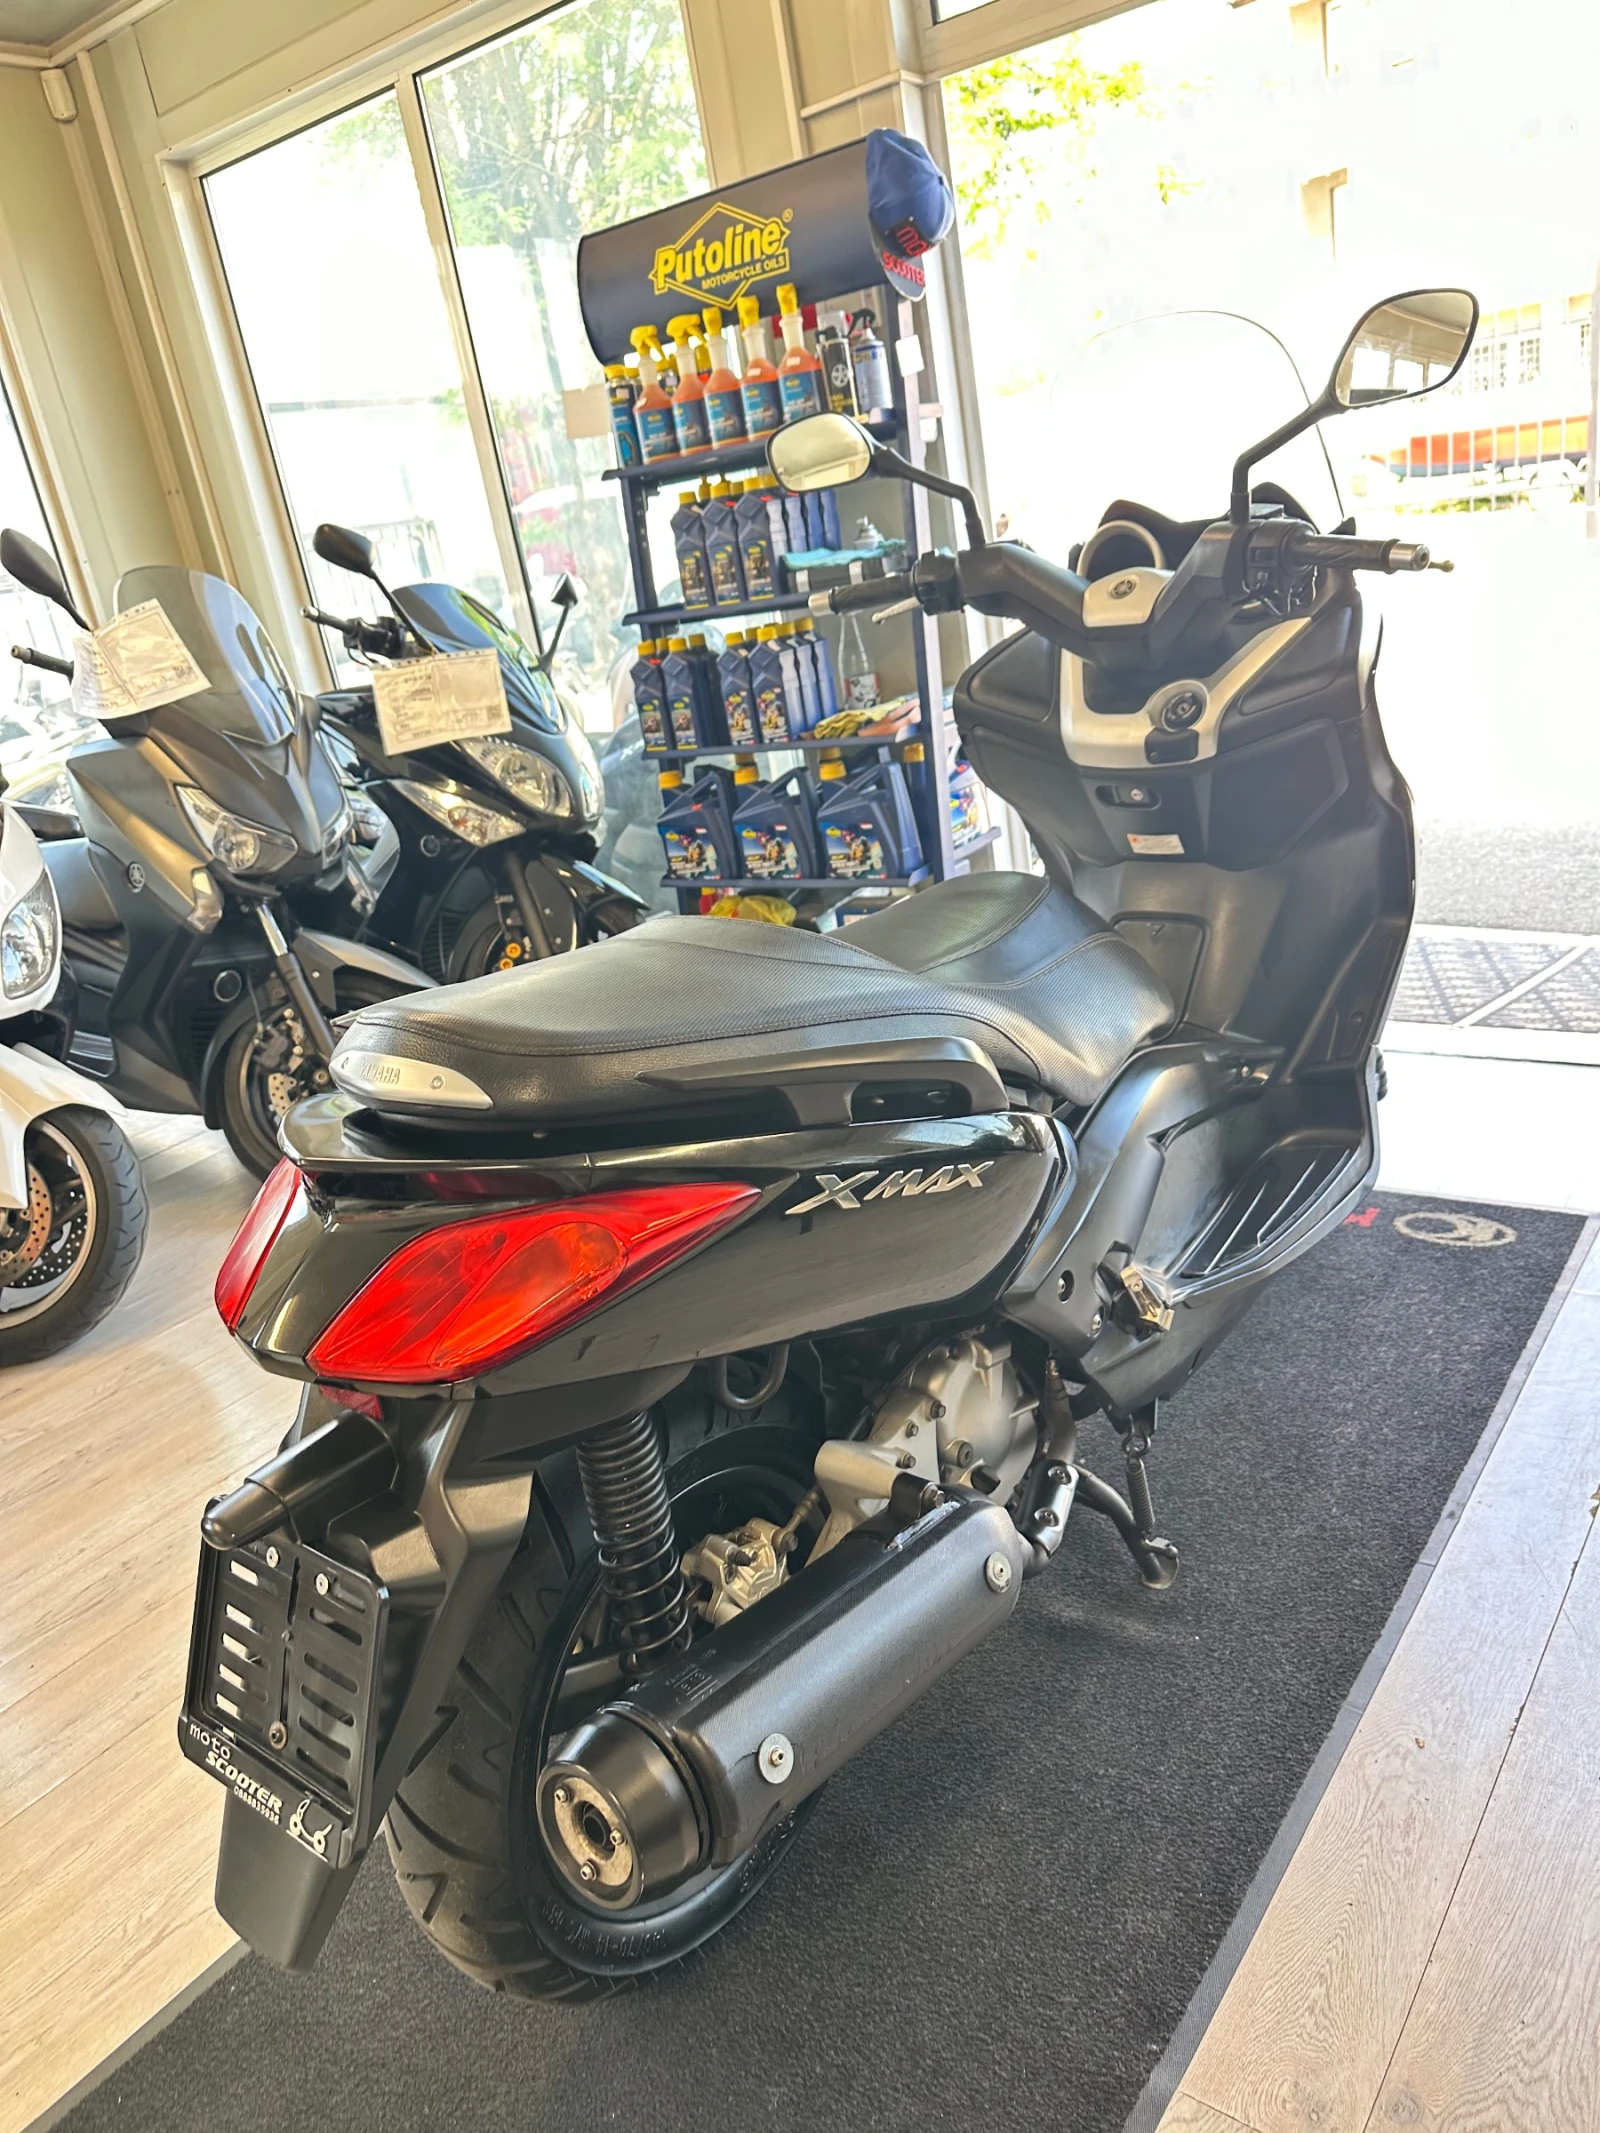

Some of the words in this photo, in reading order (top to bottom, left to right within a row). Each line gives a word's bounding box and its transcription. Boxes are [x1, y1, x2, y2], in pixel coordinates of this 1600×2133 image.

[657, 222, 781, 289] Putoline
[702, 262, 762, 290] MOTORCYCLE
[763, 256, 785, 272] OILS
[360, 1062, 401, 1085] YAMAHA
[190, 1723, 231, 1760] moto
[205, 1750, 283, 1815] SCOOTER
